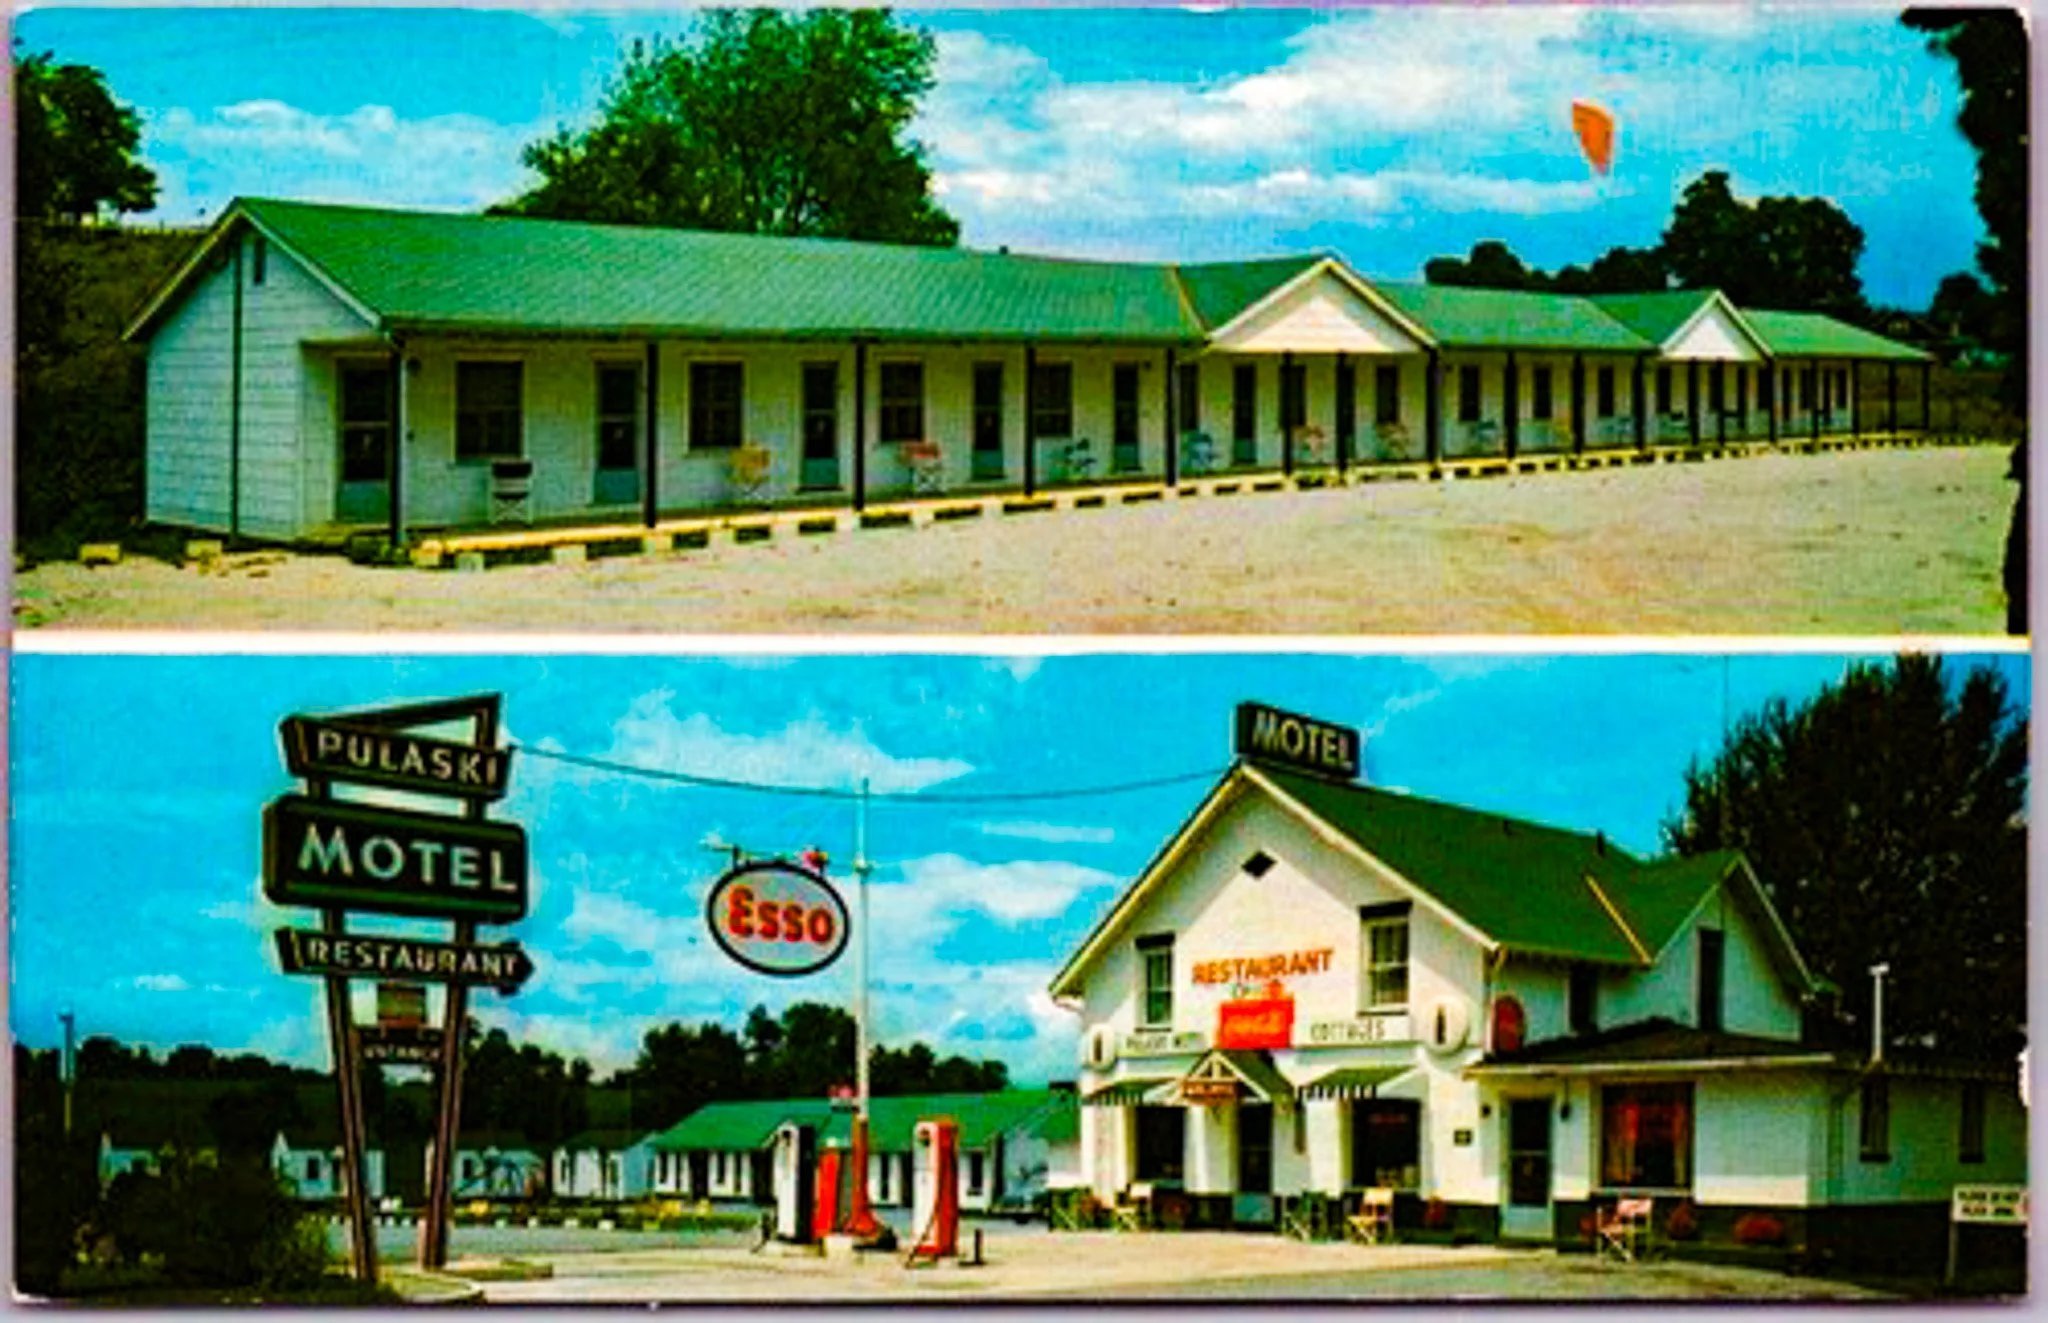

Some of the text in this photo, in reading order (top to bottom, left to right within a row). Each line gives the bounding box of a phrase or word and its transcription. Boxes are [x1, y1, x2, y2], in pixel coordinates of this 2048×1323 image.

[316, 728, 499, 785] PULASKI
[1252, 709, 1355, 772] MOTEL
[298, 821, 518, 892] MOTEL
[308, 939, 518, 977] RESTAURANT
[1192, 947, 1334, 984] RESTAURANT
